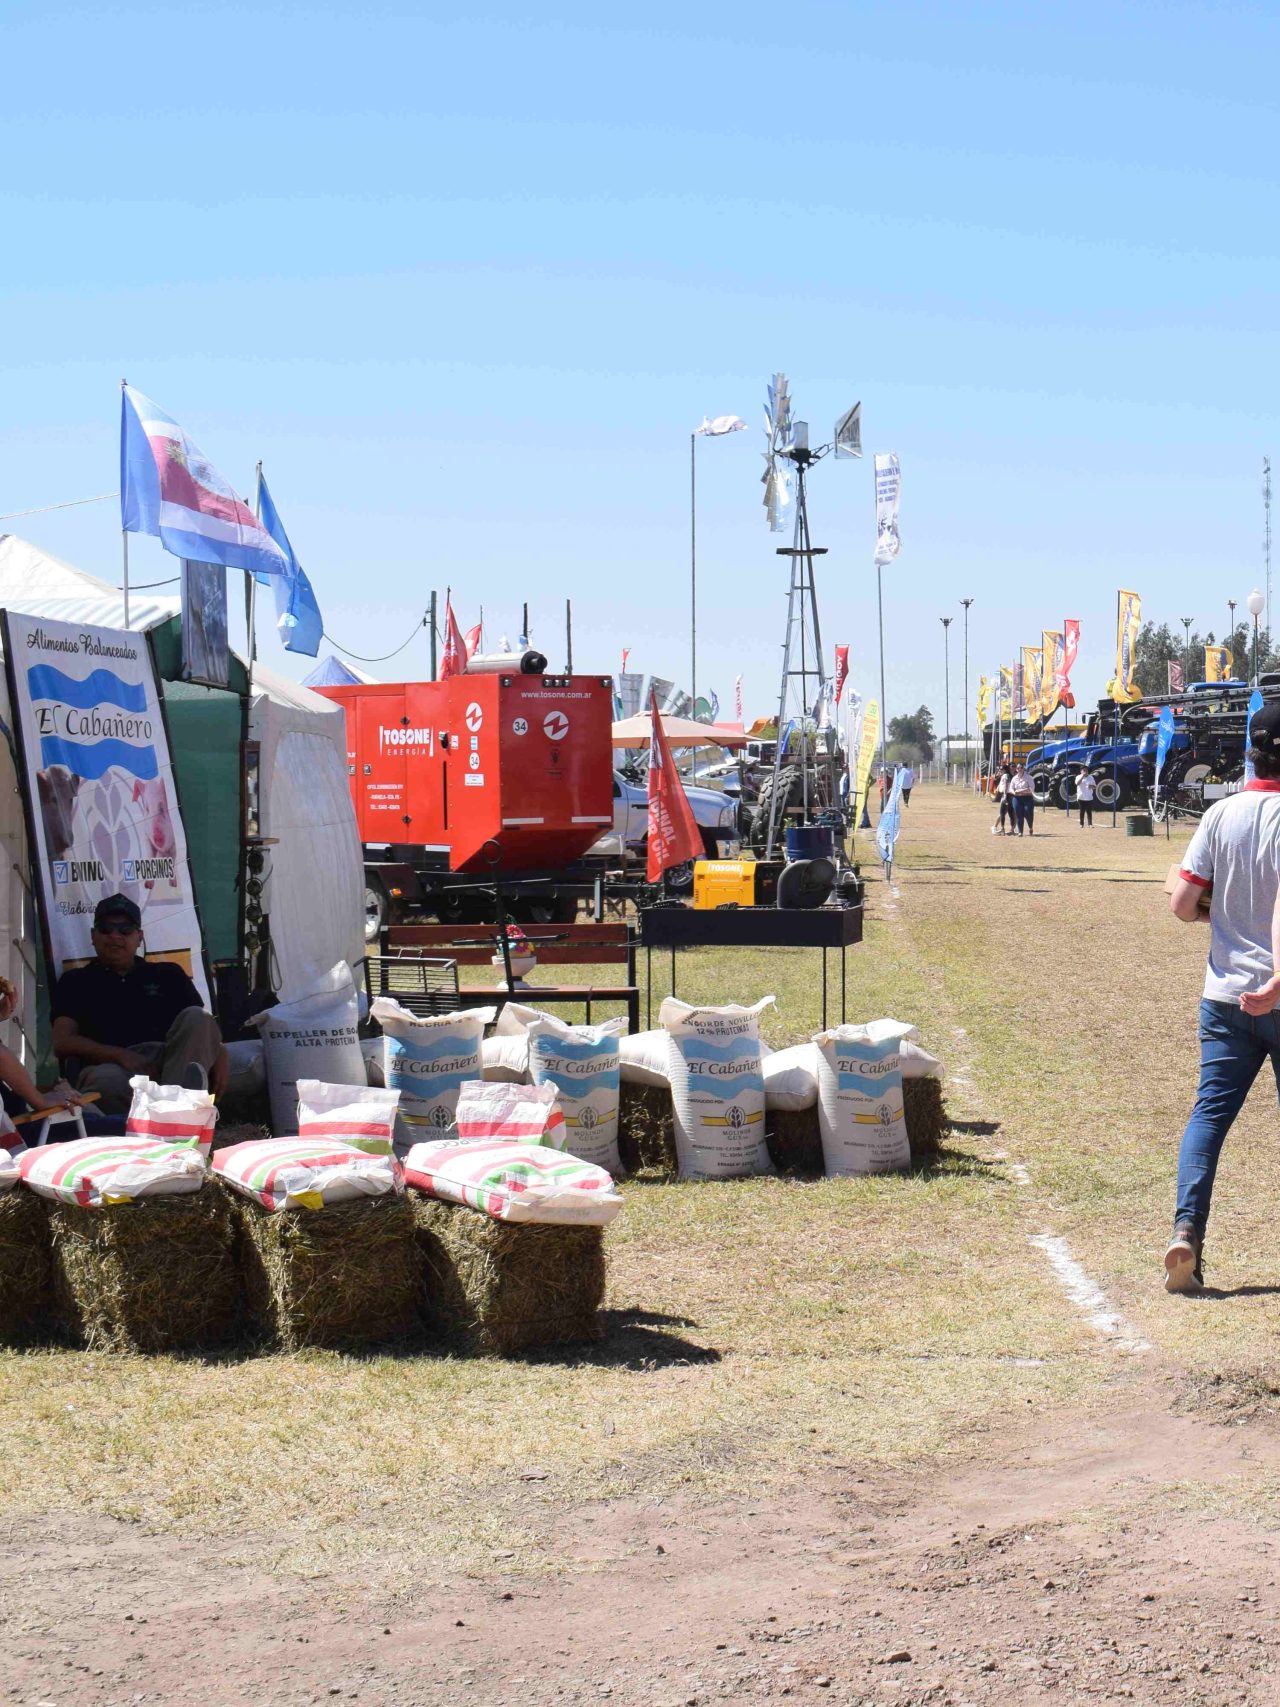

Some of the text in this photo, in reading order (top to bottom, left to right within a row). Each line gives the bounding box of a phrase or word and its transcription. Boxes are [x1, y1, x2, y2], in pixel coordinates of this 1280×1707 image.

[27, 628, 138, 660] Alimentos Balanceados
[521, 690, 592, 699] www.tosone.com.ar
[35, 704, 152, 739] El Cabañero
[513, 721, 527, 732] 34
[383, 728, 431, 746] TOSONE
[470, 756, 479, 766] 34
[269, 1029, 328, 1040] EXPELLER
[331, 1028, 344, 1036] DE
[295, 1038, 322, 1047] ALTA
[409, 1054, 479, 1073] Cabañero
[544, 1058, 563, 1071] El
[687, 1061, 706, 1074] El
[837, 1060, 856, 1073] El
